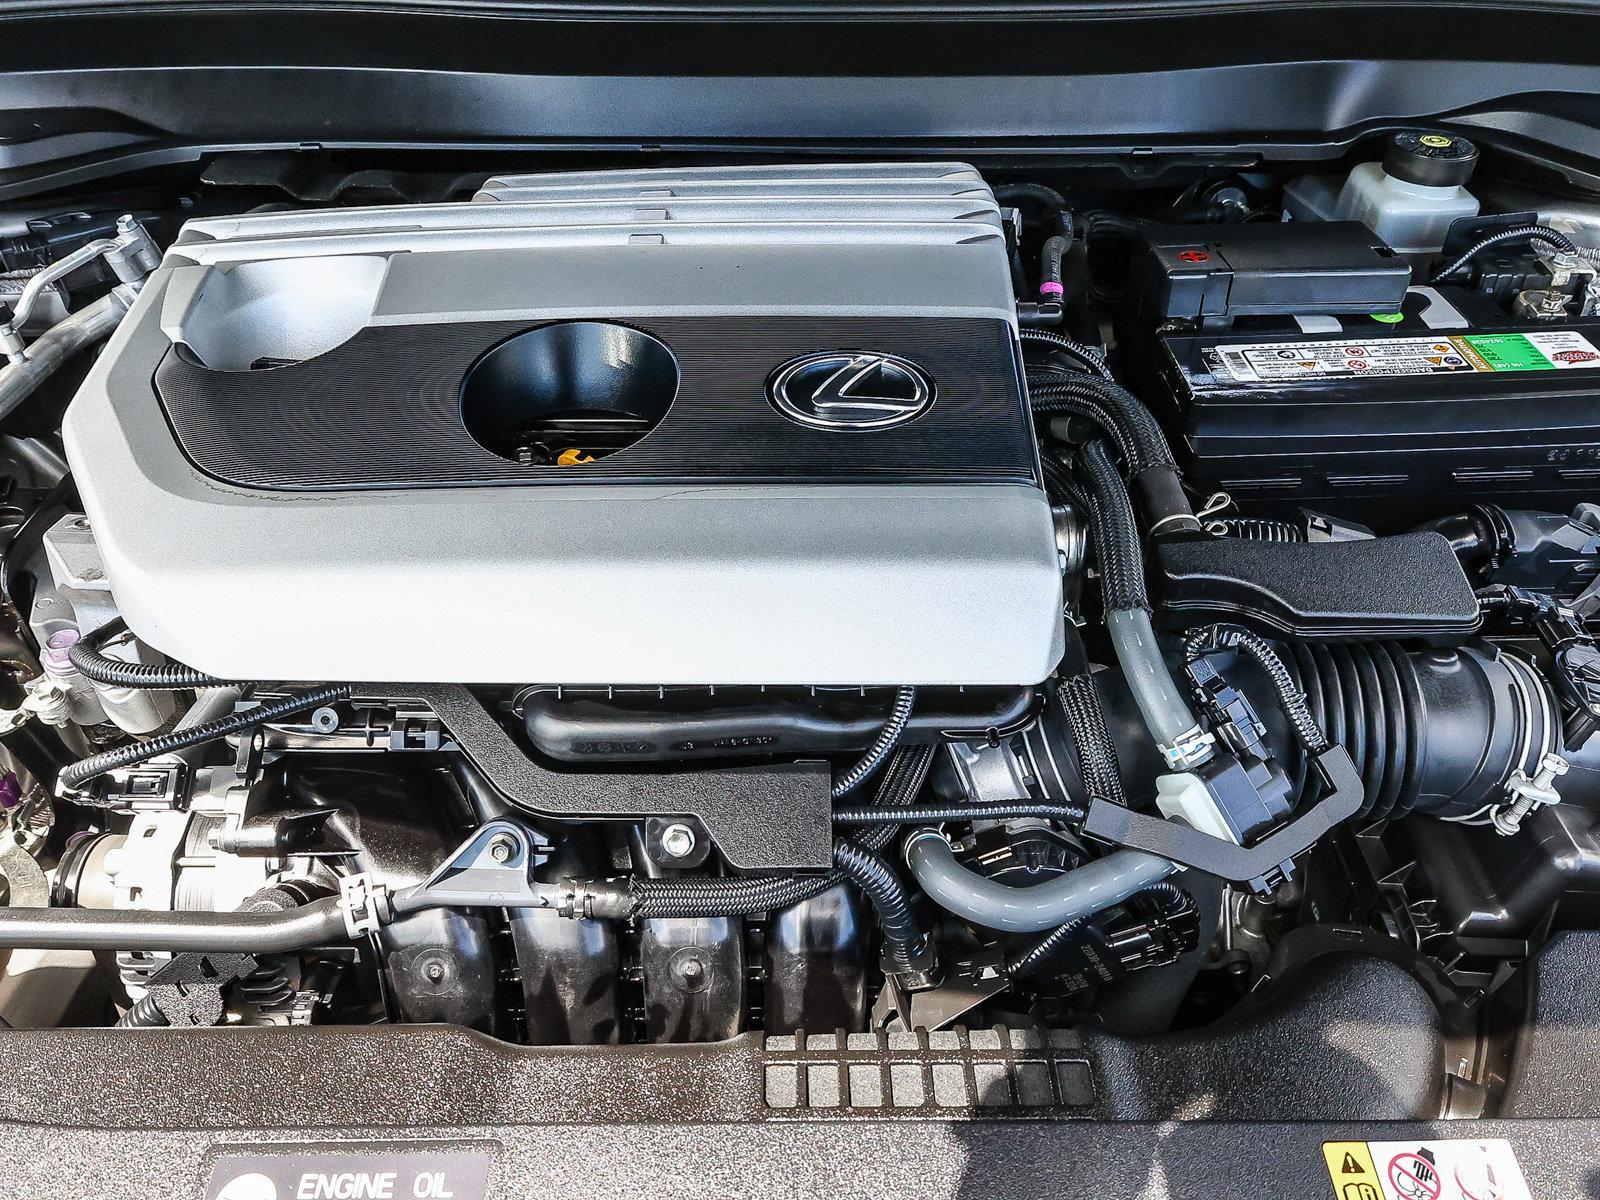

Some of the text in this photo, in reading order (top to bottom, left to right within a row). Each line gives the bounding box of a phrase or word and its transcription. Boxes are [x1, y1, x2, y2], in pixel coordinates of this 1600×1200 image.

[1453, 338, 1489, 370] AUTOMOTIVE
[1353, 367, 1434, 376] DANGER/POISON
[296, 1172, 454, 1200] ENGINE OIL
